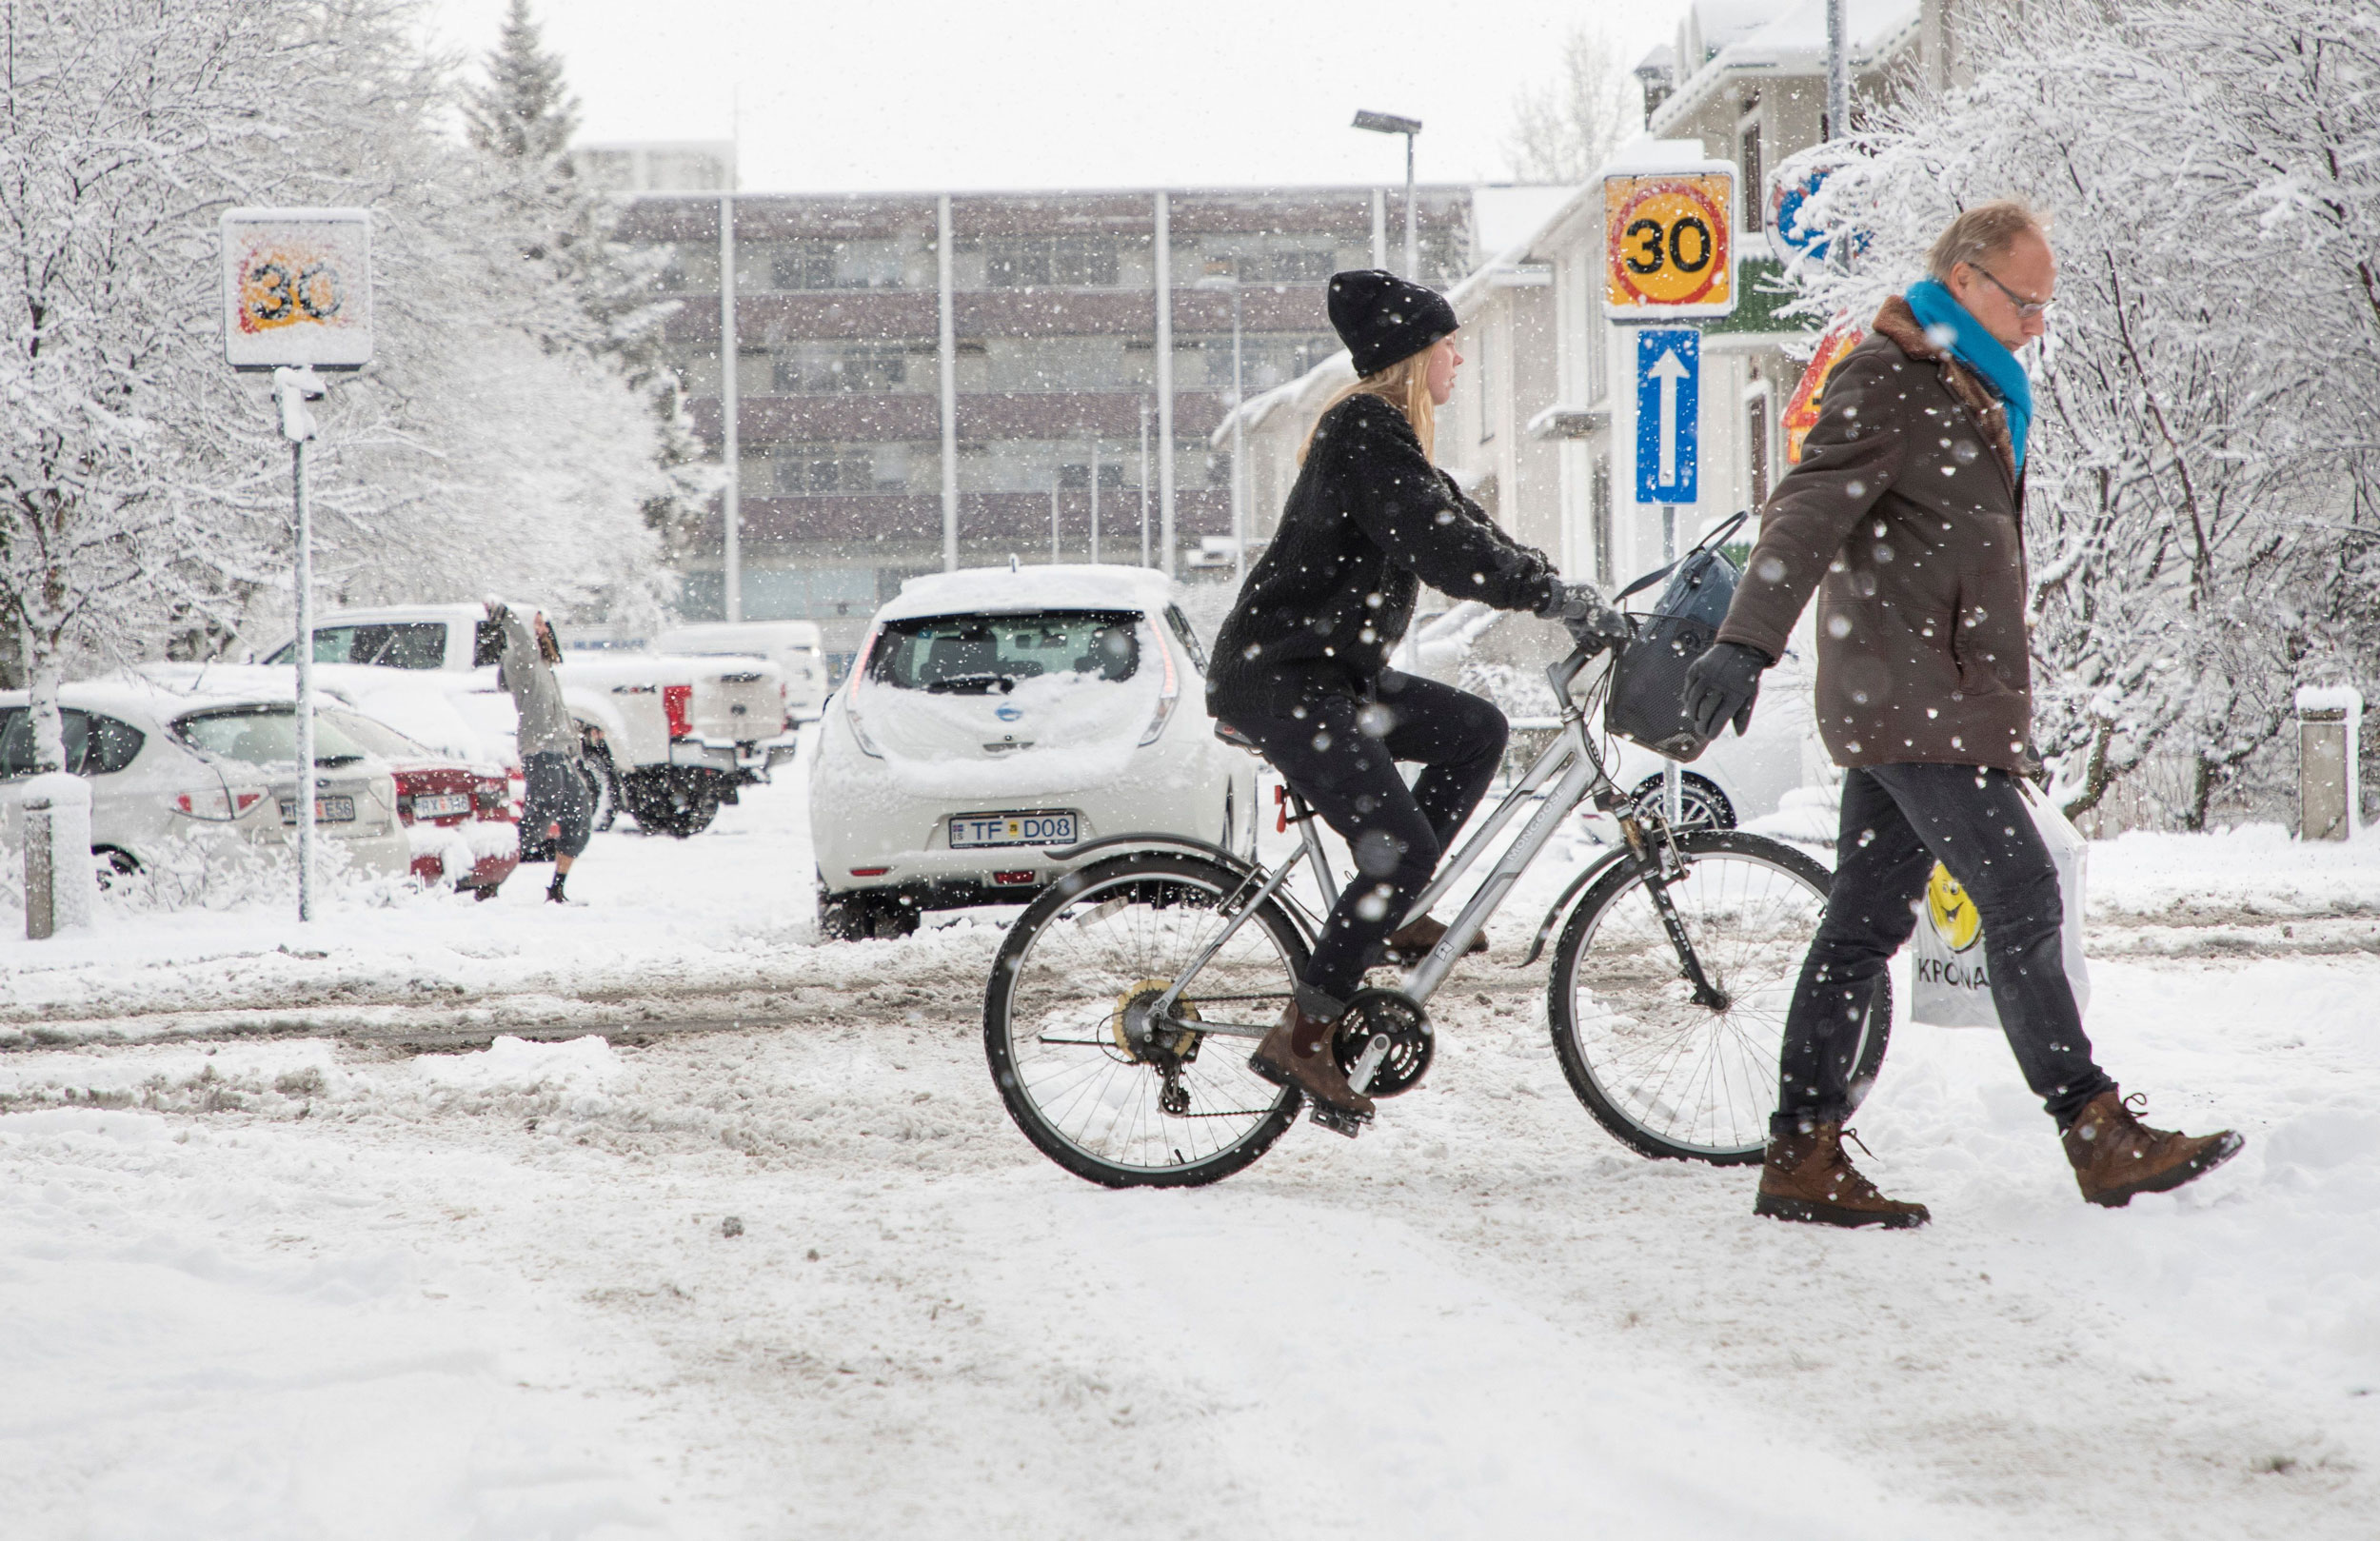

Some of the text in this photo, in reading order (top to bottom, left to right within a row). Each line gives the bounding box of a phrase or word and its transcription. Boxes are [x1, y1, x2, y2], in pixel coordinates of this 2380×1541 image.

[1626, 217, 1711, 275] 30
[250, 262, 343, 320] 30
[970, 821, 1002, 840] TF
[1024, 819, 1070, 838] D08
[1506, 785, 1566, 860] MONGOOSE
